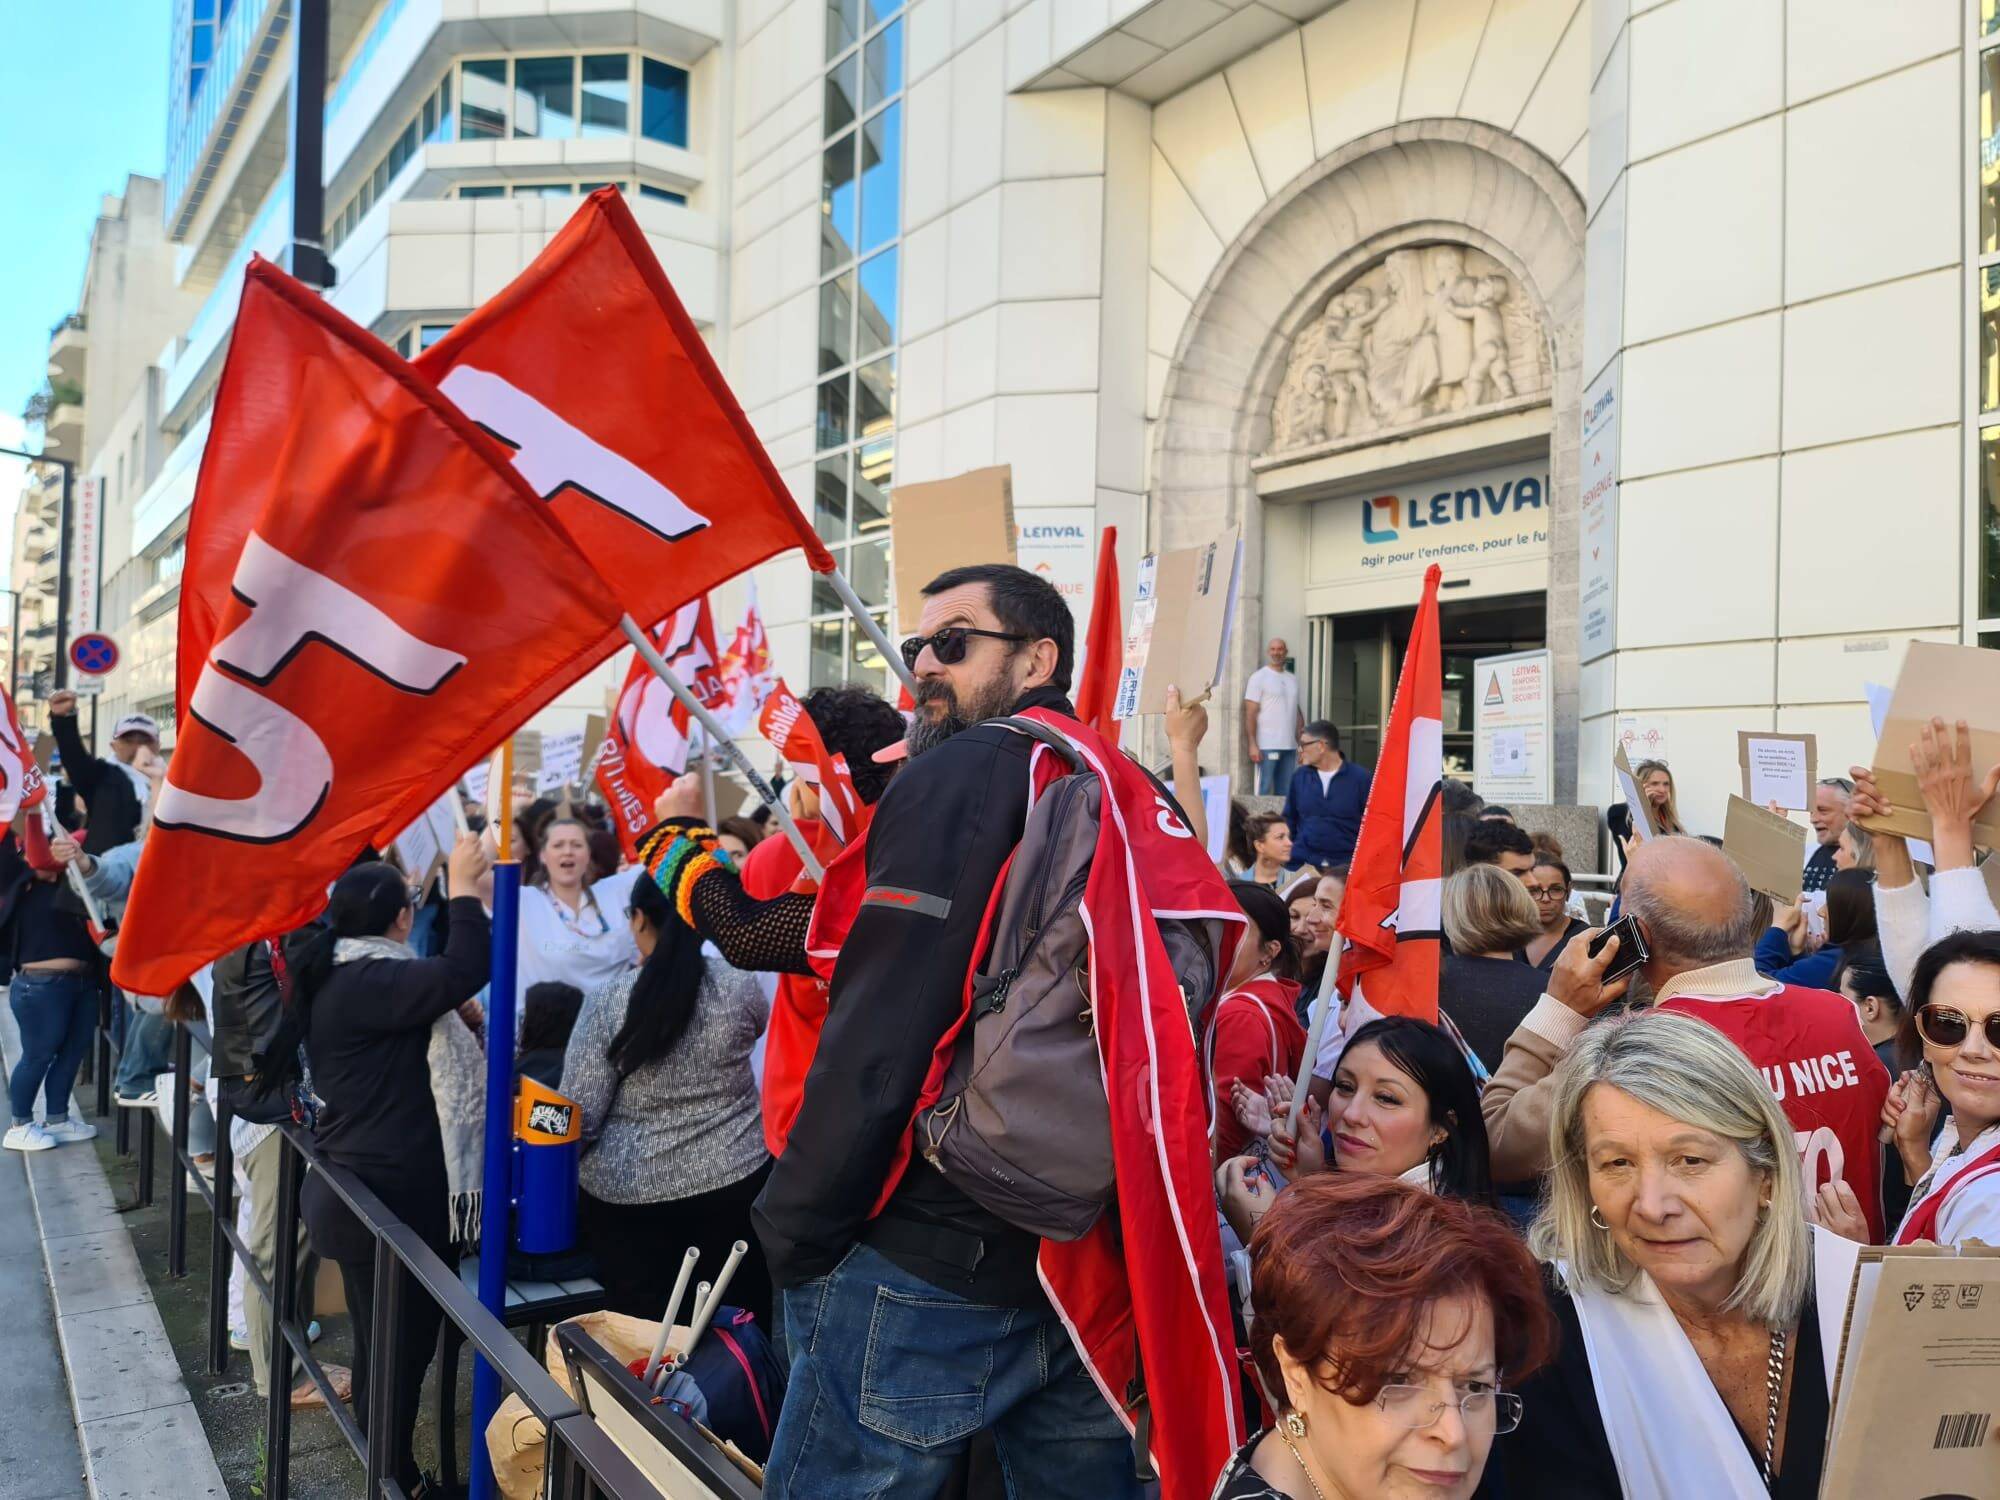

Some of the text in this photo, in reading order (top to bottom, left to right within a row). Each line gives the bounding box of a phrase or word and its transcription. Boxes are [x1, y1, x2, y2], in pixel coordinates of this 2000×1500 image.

[1023, 526, 1084, 538] LENVAL
[1361, 554, 1385, 567] Agir
[1387, 551, 1414, 565] pour
[1418, 541, 1479, 559] l'enfance,
[1482, 536, 1512, 552] pour
[1517, 533, 1529, 545] le
[1789, 1050, 1859, 1097] NICE
